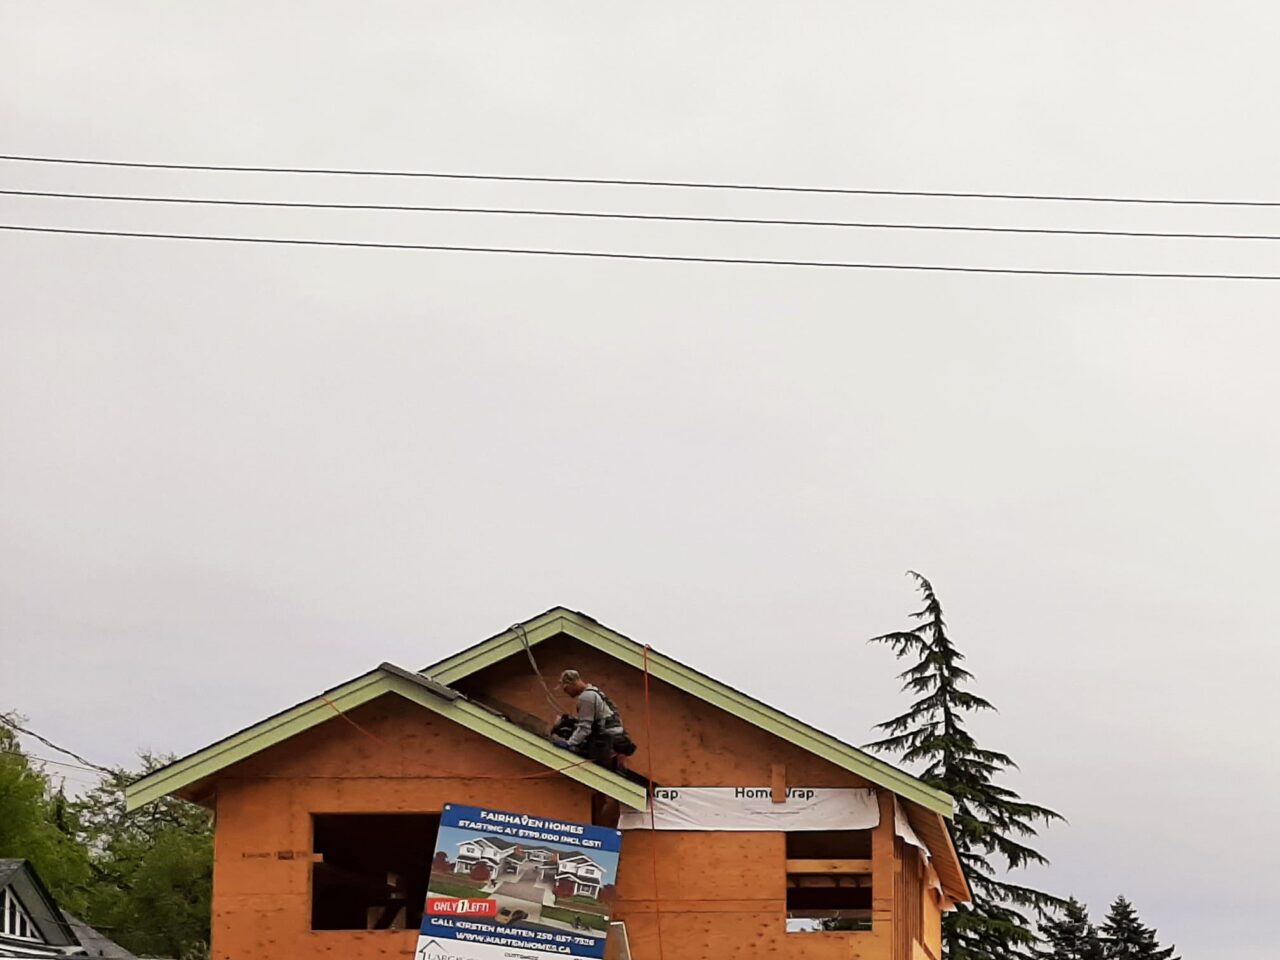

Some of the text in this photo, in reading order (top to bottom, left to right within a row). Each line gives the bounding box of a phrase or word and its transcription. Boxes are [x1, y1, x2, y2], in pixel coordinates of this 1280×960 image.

[458, 820, 504, 833] STARTING
[504, 826, 518, 835] AT
[480, 811, 584, 835] FAIRHAVEN HOMES
[433, 901, 457, 912] ONLY
[431, 918, 454, 928] CALL
[496, 927, 535, 939] MARTEN
